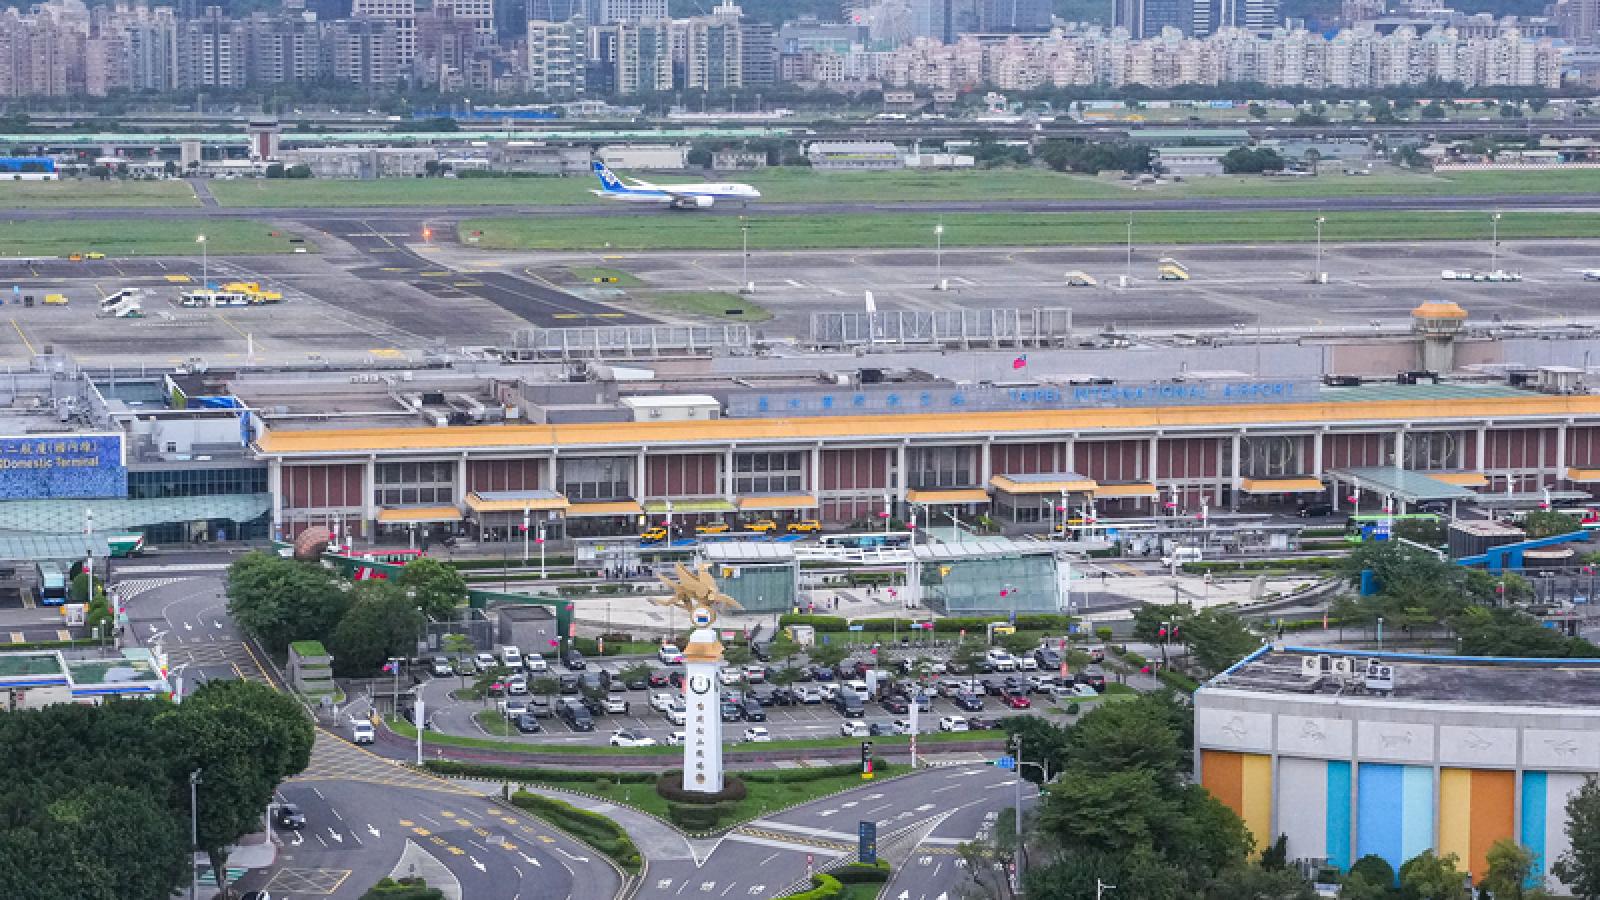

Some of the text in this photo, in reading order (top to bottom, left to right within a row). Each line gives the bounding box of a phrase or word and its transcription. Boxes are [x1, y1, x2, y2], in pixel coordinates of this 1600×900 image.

[1008, 383, 1294, 402] TAIPEI INTERNATIONAL AIRPORT
